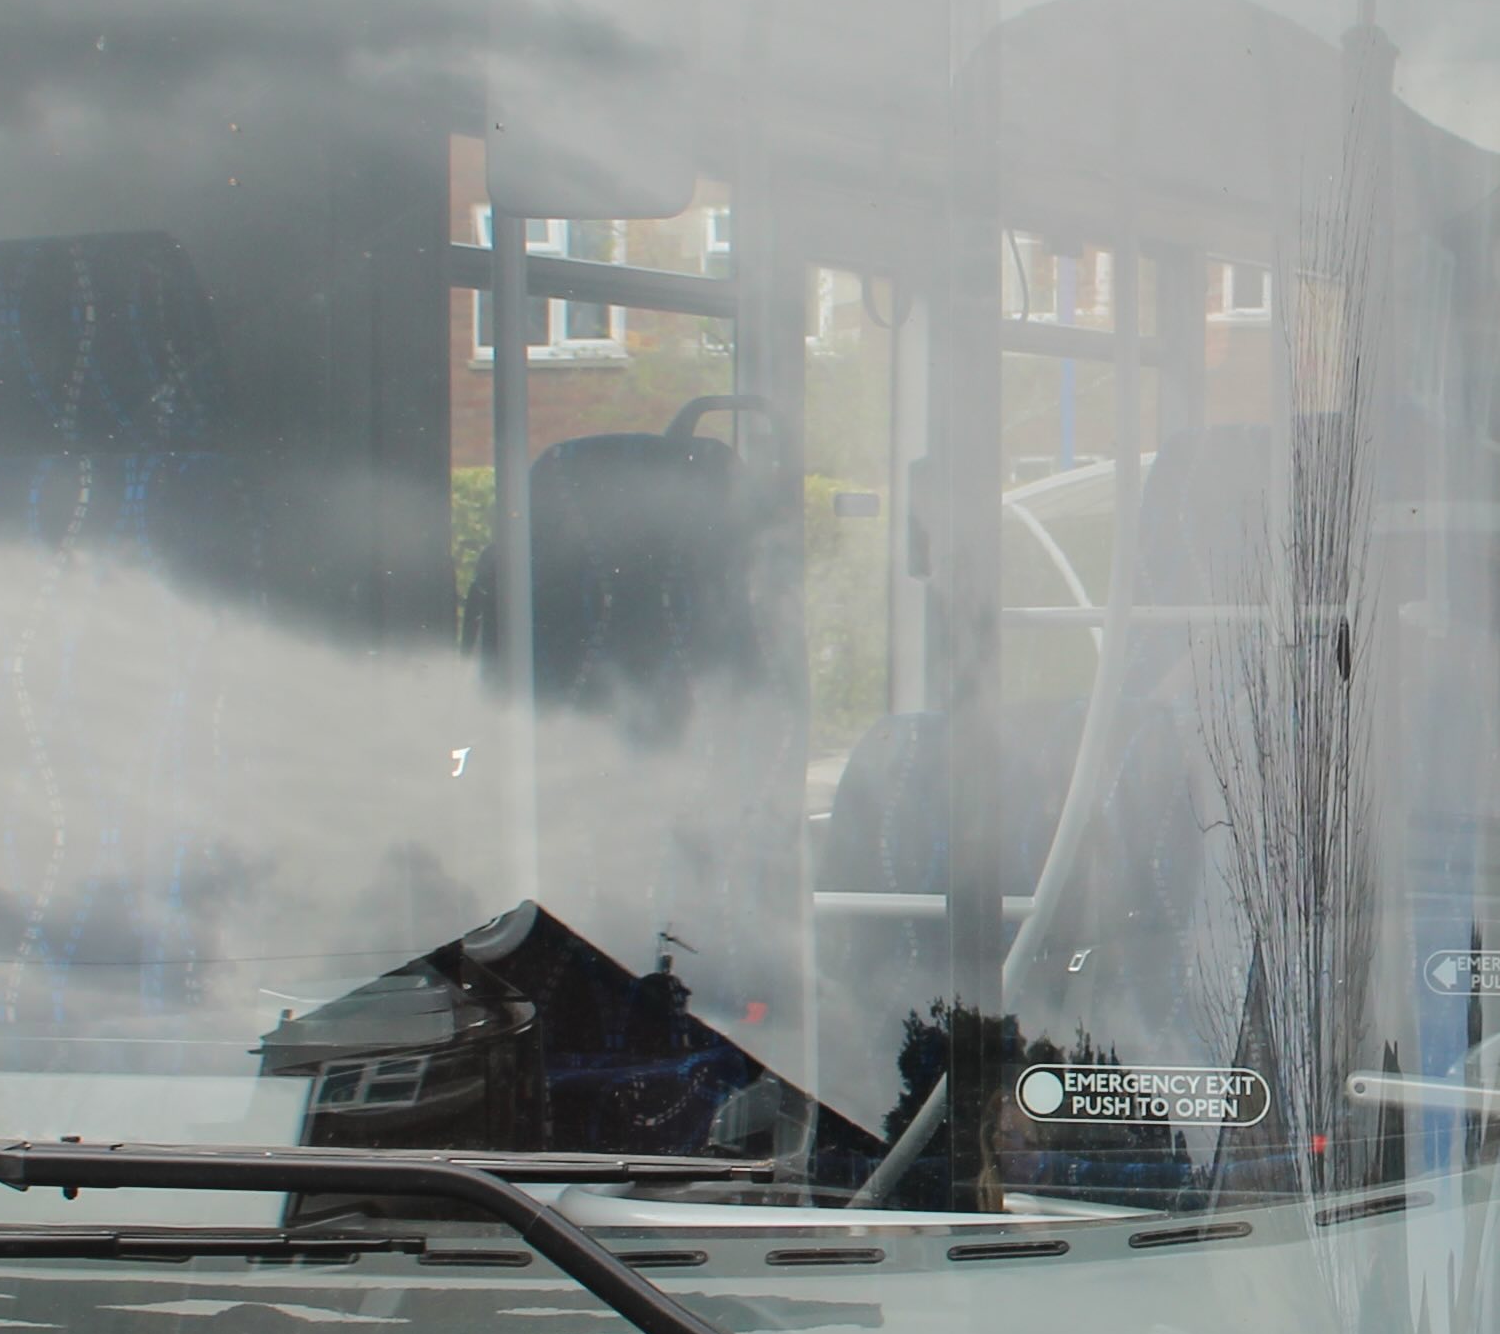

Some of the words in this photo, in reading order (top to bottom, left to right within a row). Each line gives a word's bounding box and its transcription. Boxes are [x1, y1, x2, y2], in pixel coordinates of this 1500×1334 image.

[1064, 1072, 1200, 1095] EMERGENCY
[1206, 1075, 1256, 1096] EXIT
[1072, 1096, 1131, 1116] PUSH
[1137, 1097, 1169, 1117] TO
[1176, 1098, 1238, 1118] OPEN
